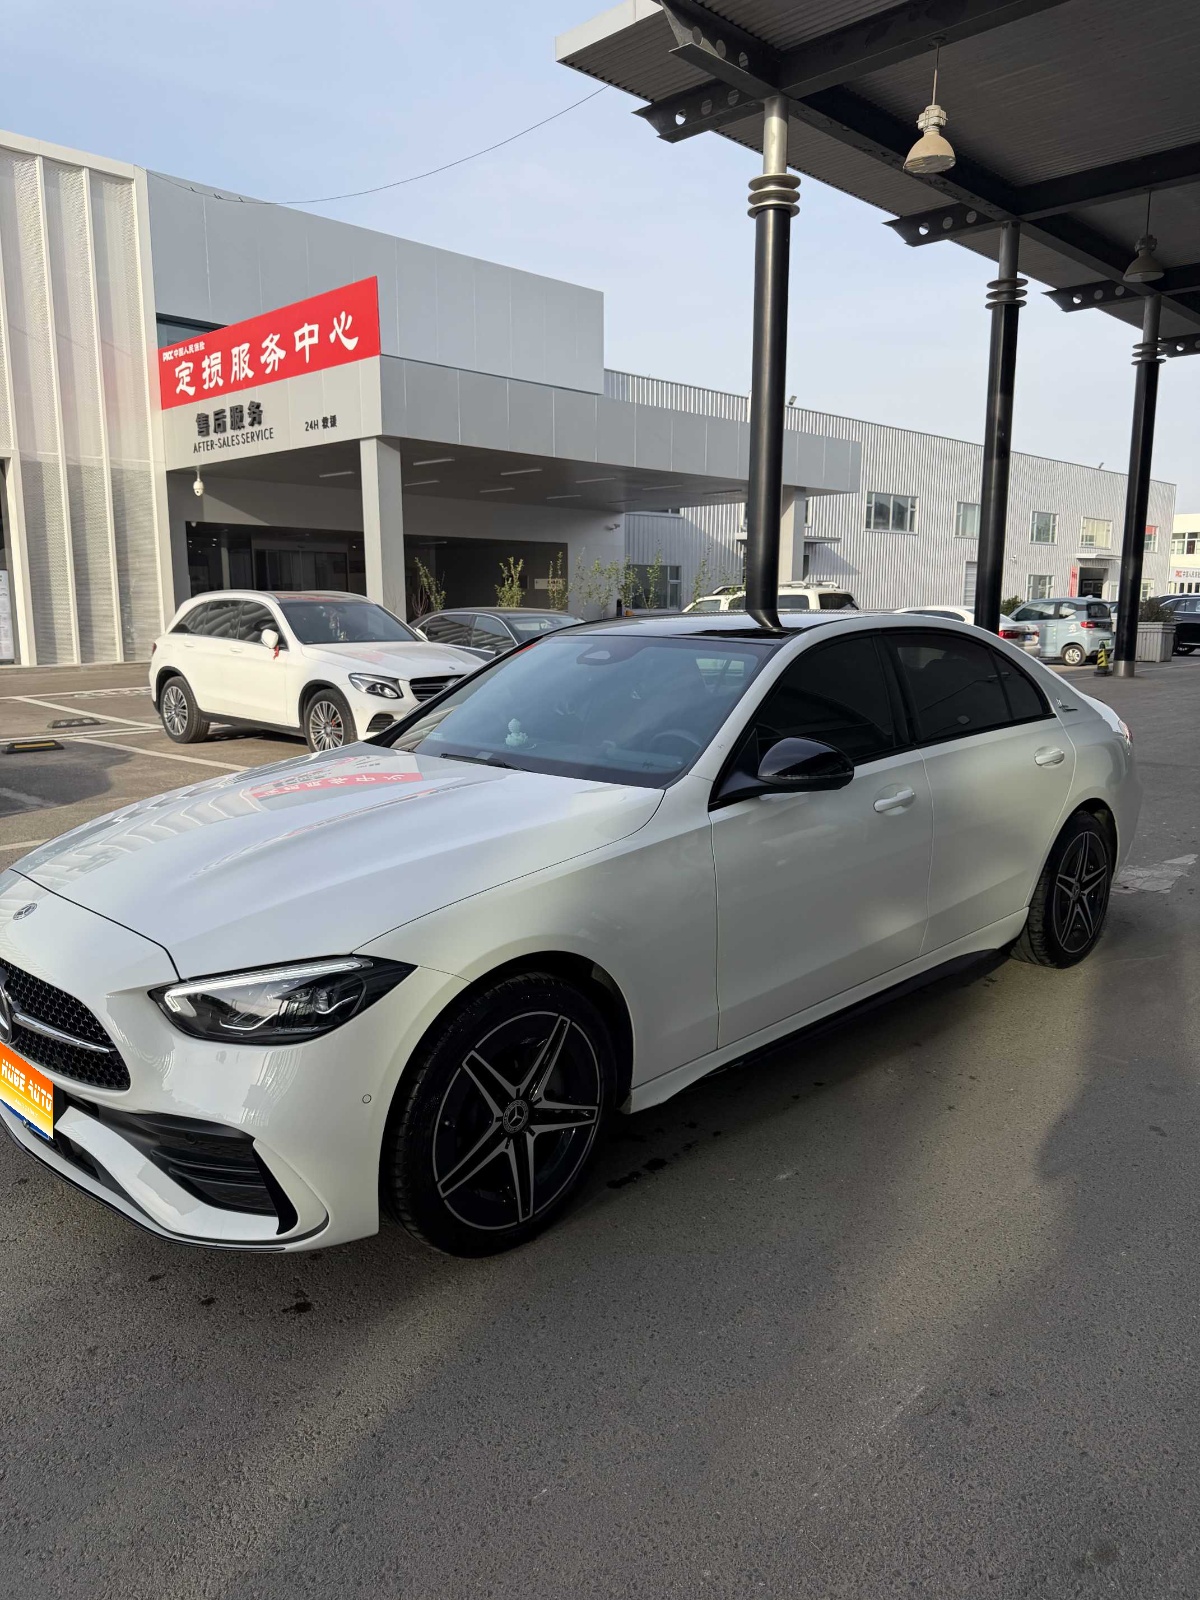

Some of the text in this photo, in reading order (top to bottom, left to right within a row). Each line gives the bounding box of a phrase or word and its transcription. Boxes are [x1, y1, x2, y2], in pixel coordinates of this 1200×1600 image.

[174, 310, 360, 396] 定损服务中心
[195, 400, 263, 437] 售后服务
[305, 415, 337, 432] 24H 救援
[193, 427, 275, 454] AFTER-SALES SERVICE
